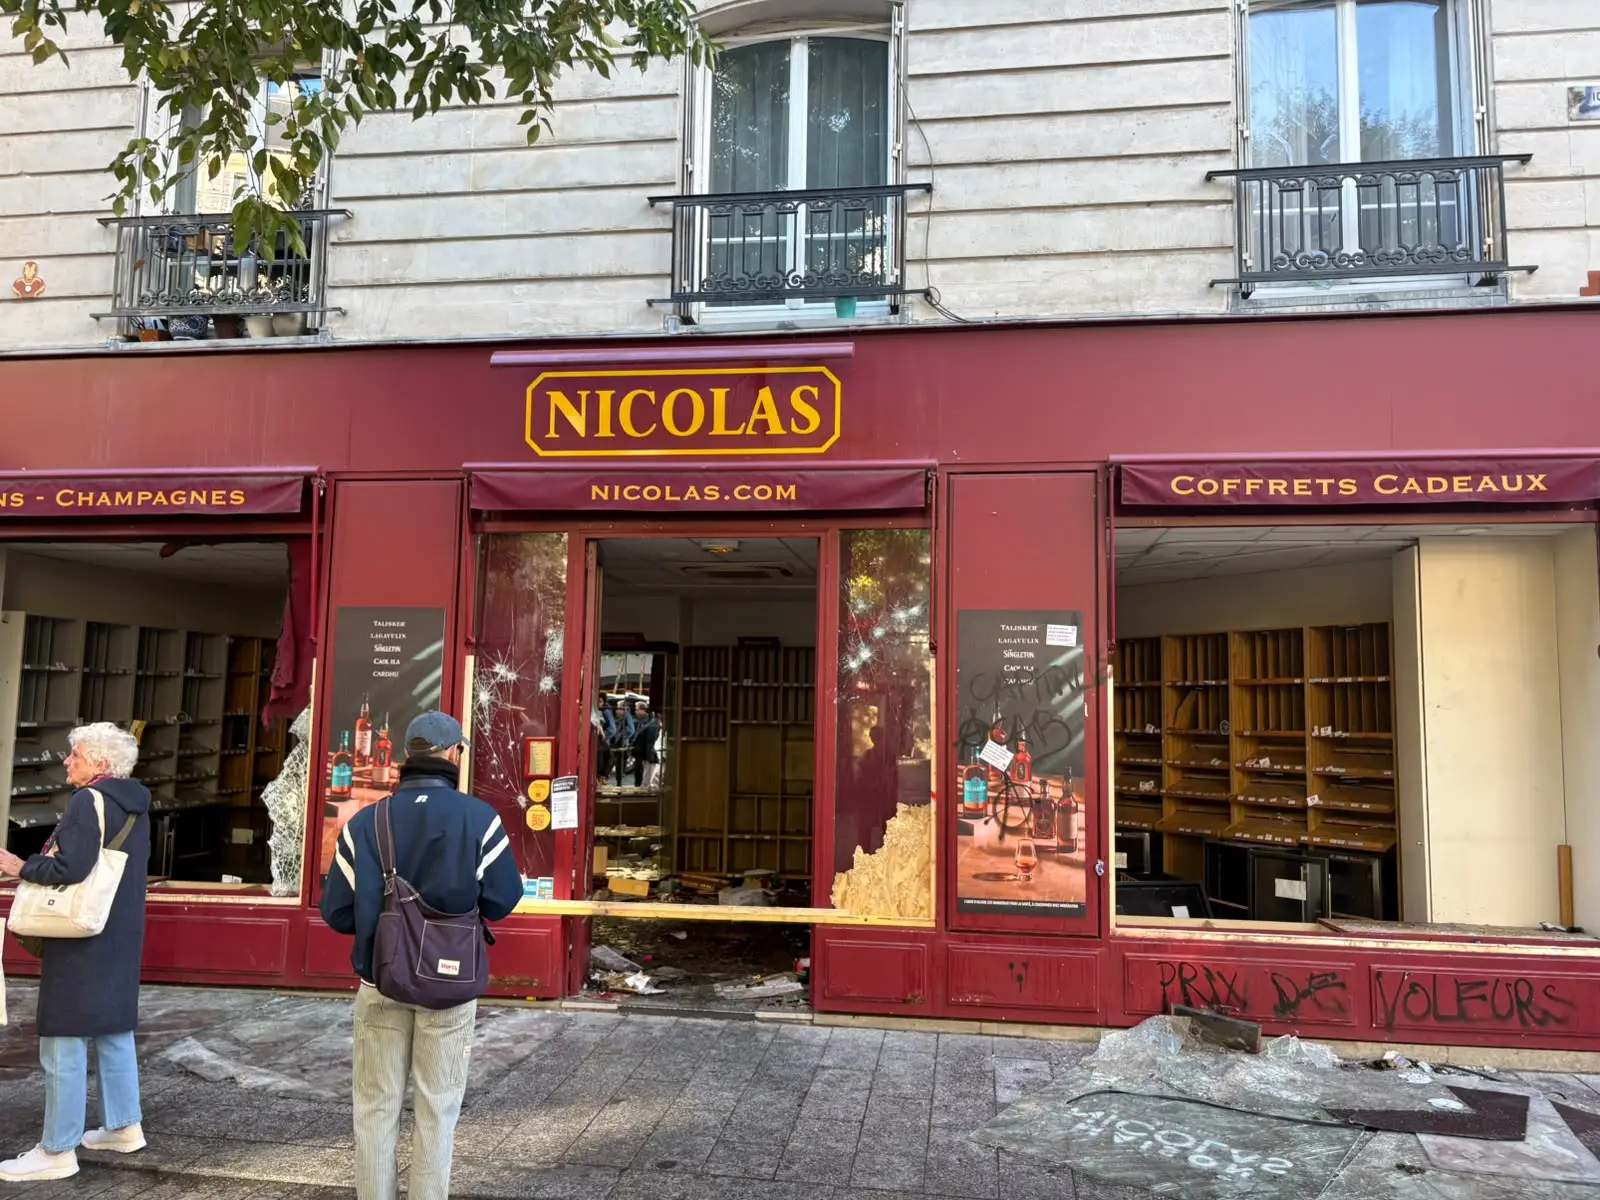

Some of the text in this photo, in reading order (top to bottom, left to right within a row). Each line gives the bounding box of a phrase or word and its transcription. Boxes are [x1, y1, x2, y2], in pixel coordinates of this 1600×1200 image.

[544, 385, 822, 438] NICOLAS
[591, 484, 797, 501] NICOLAS.COM
[1157, 961, 1577, 1032] PRIX DE VOLEURS
